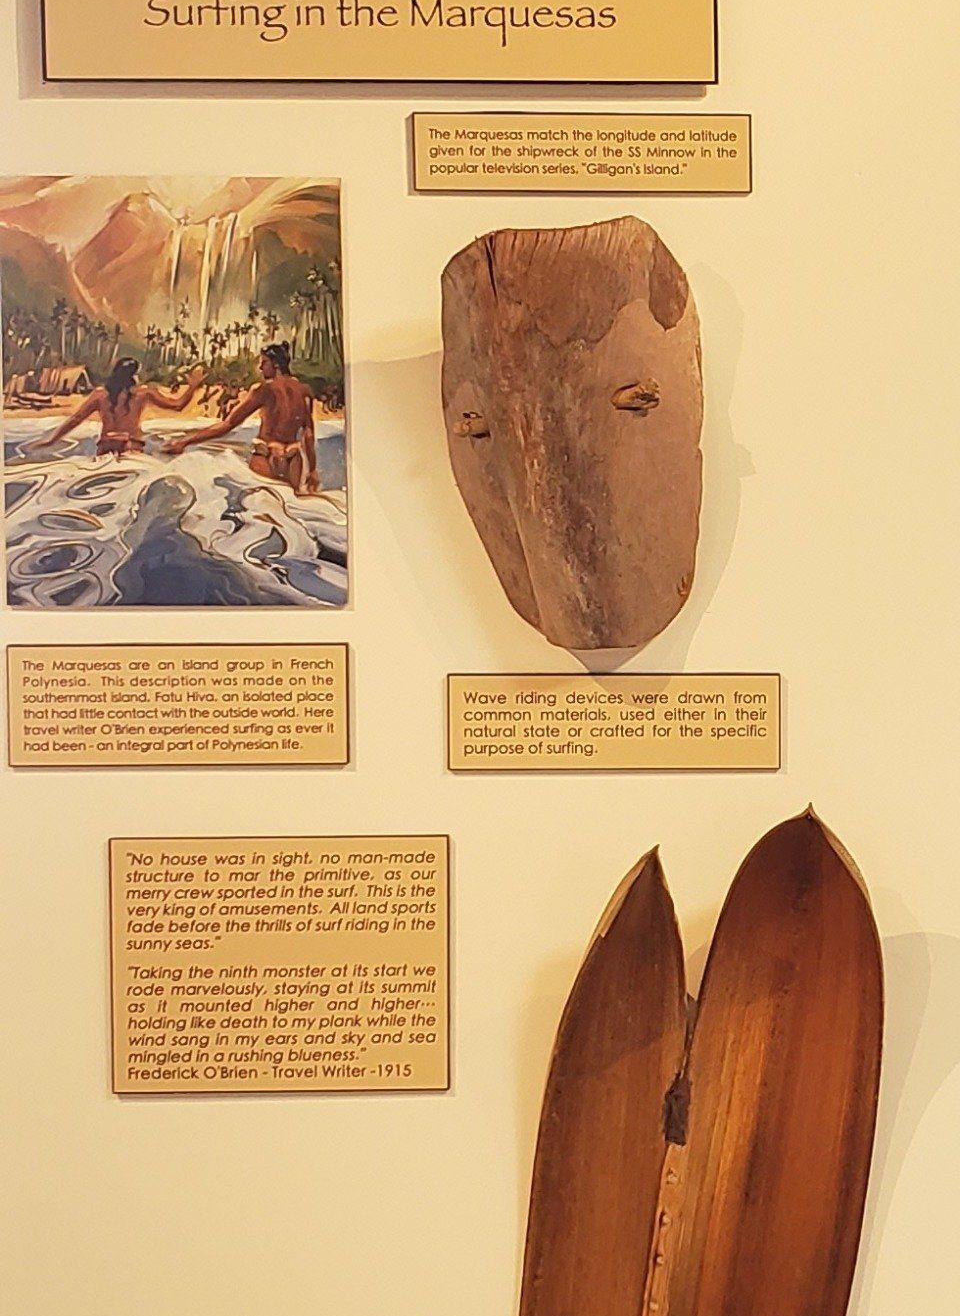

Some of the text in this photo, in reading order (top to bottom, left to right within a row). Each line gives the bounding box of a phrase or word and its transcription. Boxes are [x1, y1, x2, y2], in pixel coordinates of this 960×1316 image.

[428, 127, 738, 144] The Marquesas match the longitude and latitude
[428, 144, 738, 160] given for the shipwreck of the SS Minnow in the
[429, 161, 479, 176] popular
[481, 162, 540, 174] television
[22, 674, 334, 690] Polynesia. This description was made on the
[462, 690, 767, 707] Wave riding devices were drawn from
[22, 706, 334, 720] that had little contact with the outside world. Here
[462, 710, 532, 722] common
[619, 707, 655, 722] used
[663, 707, 706, 722] either
[713, 707, 727, 721] in
[734, 707, 768, 721] their
[463, 723, 767, 741] natural state or crafted for the specific
[463, 740, 598, 757] purpose of surfing.
[125, 869, 195, 883] structure
[203, 868, 220, 883] to
[227, 871, 261, 882] mar
[269, 868, 295, 882] the
[383, 869, 402, 881] as
[409, 869, 437, 881] our
[126, 900, 437, 919] very king of amusements. All land sports
[125, 935, 222, 953] sunny seas."
[125, 979, 437, 998] rode marvelously, staying at its summit
[127, 1065, 200, 1081] Frederick
[202, 1064, 258, 1080] O'Brien
[271, 1064, 318, 1079] Travel
[321, 1063, 367, 1078] Writer
